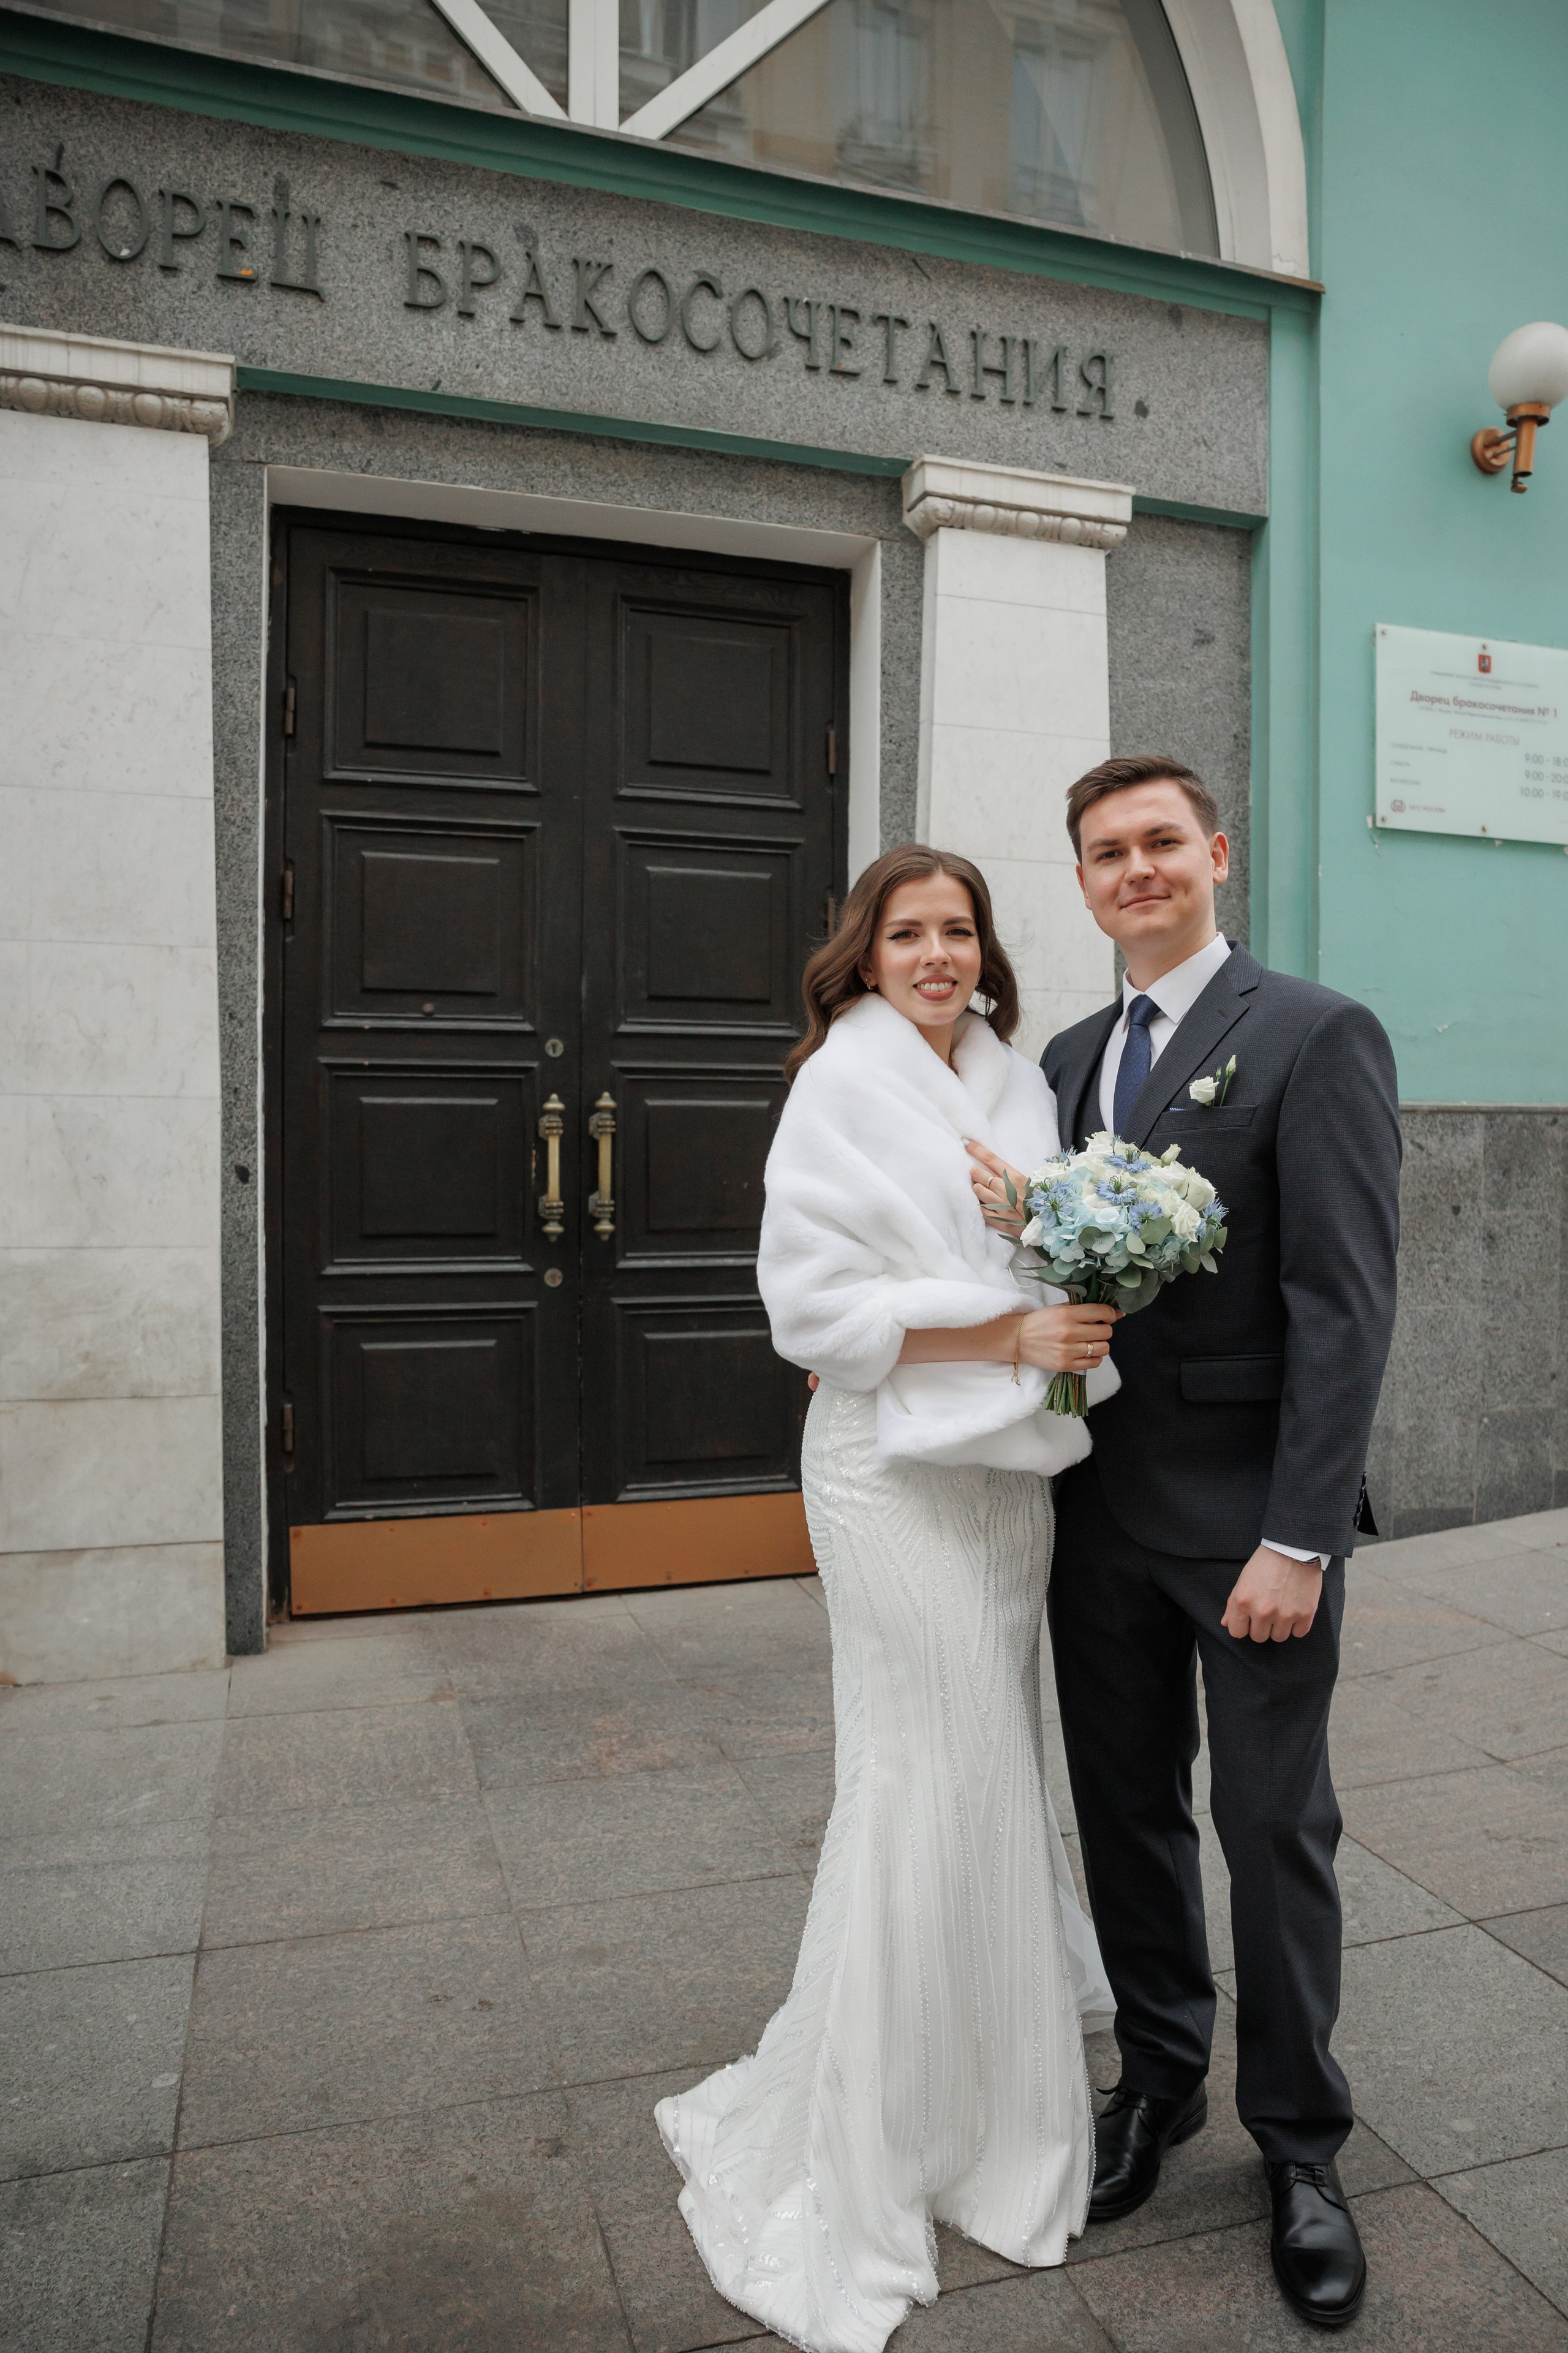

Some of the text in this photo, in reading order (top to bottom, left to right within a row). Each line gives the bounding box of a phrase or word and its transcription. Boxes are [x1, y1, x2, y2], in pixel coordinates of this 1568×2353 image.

[404, 231, 1115, 420] БРАКОСОЧЕТАНИЯ
[1410, 690, 1450, 706] Дворец
[1452, 695, 1536, 716] бракосочетания
[1537, 706, 1550, 717] №
[1449, 728, 1520, 746] РЕЖИМ РАБОТЫ
